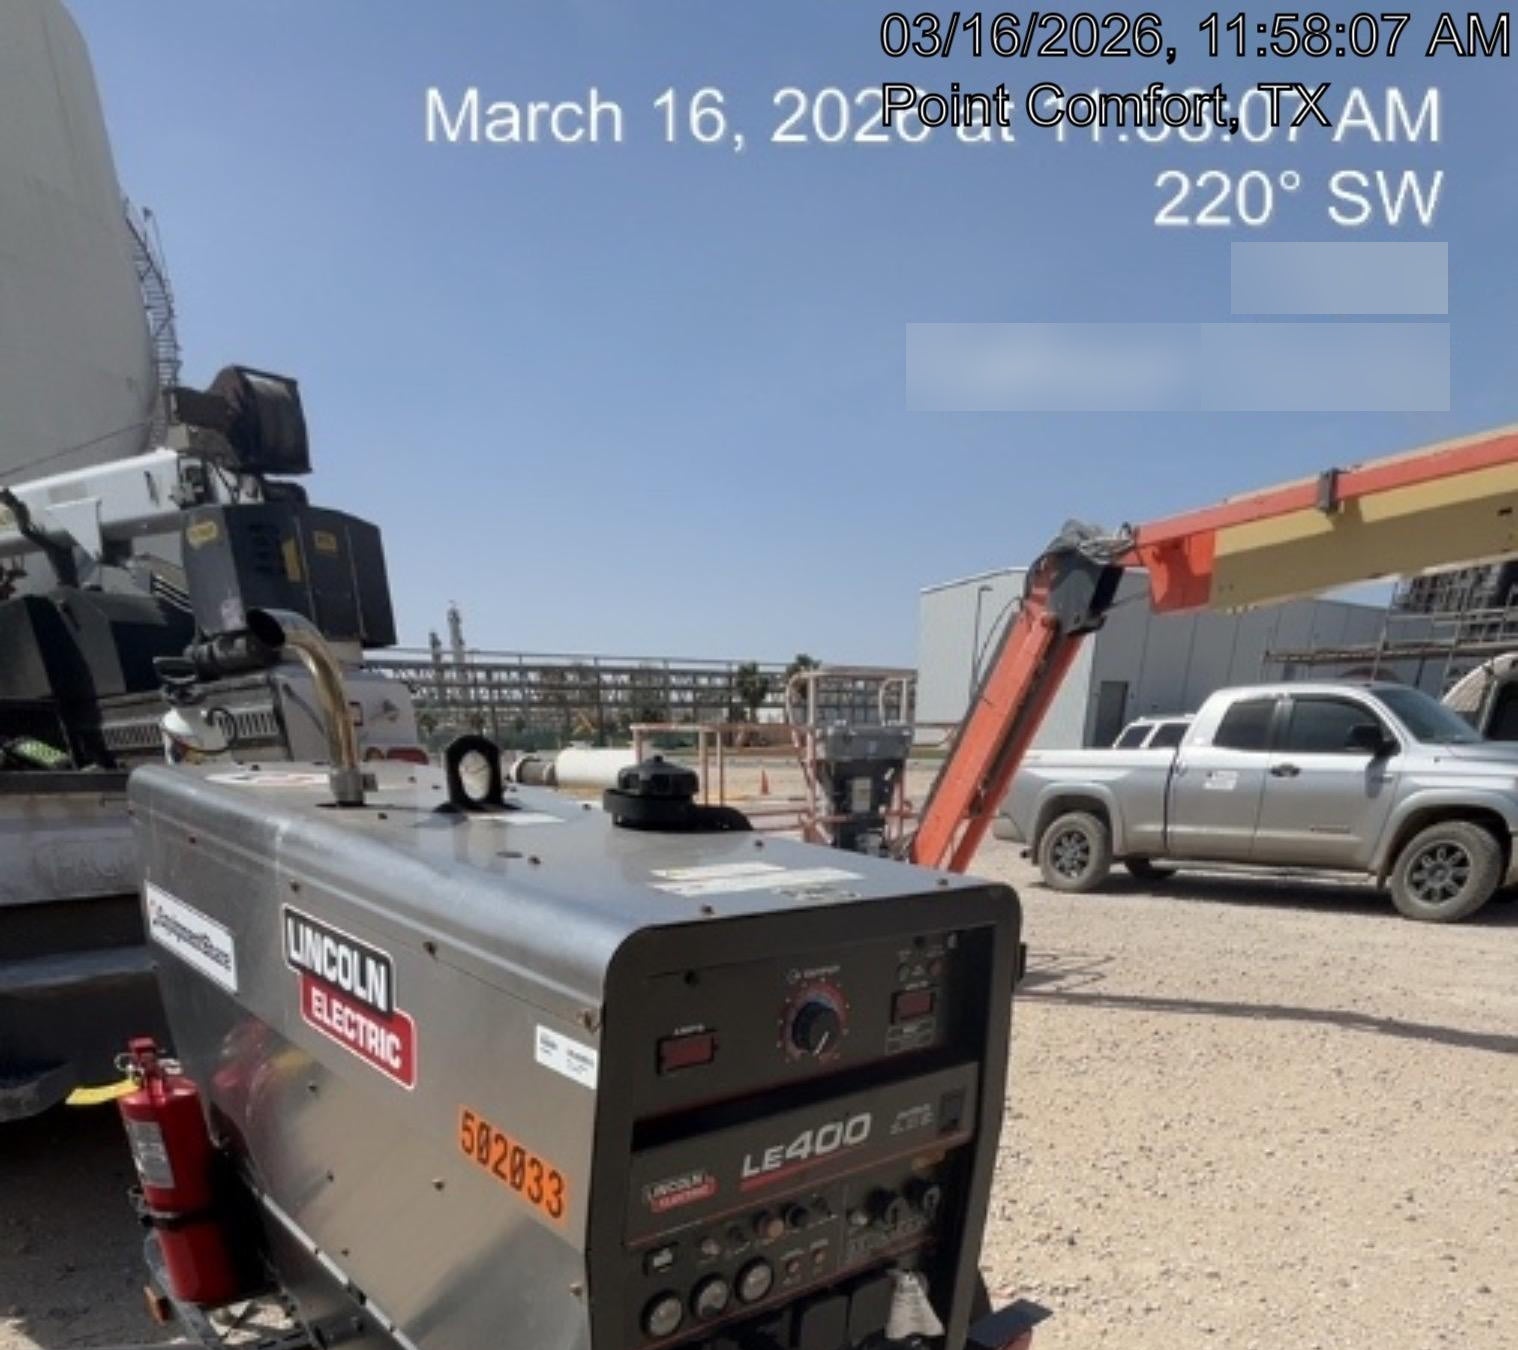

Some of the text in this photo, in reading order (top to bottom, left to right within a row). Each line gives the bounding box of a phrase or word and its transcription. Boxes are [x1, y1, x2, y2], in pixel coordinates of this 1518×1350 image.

[286, 917, 389, 1012] LINCOLN
[311, 985, 402, 1069] ELECTRIC
[461, 1110, 564, 1218] 502033
[742, 1112, 872, 1178] LE400
